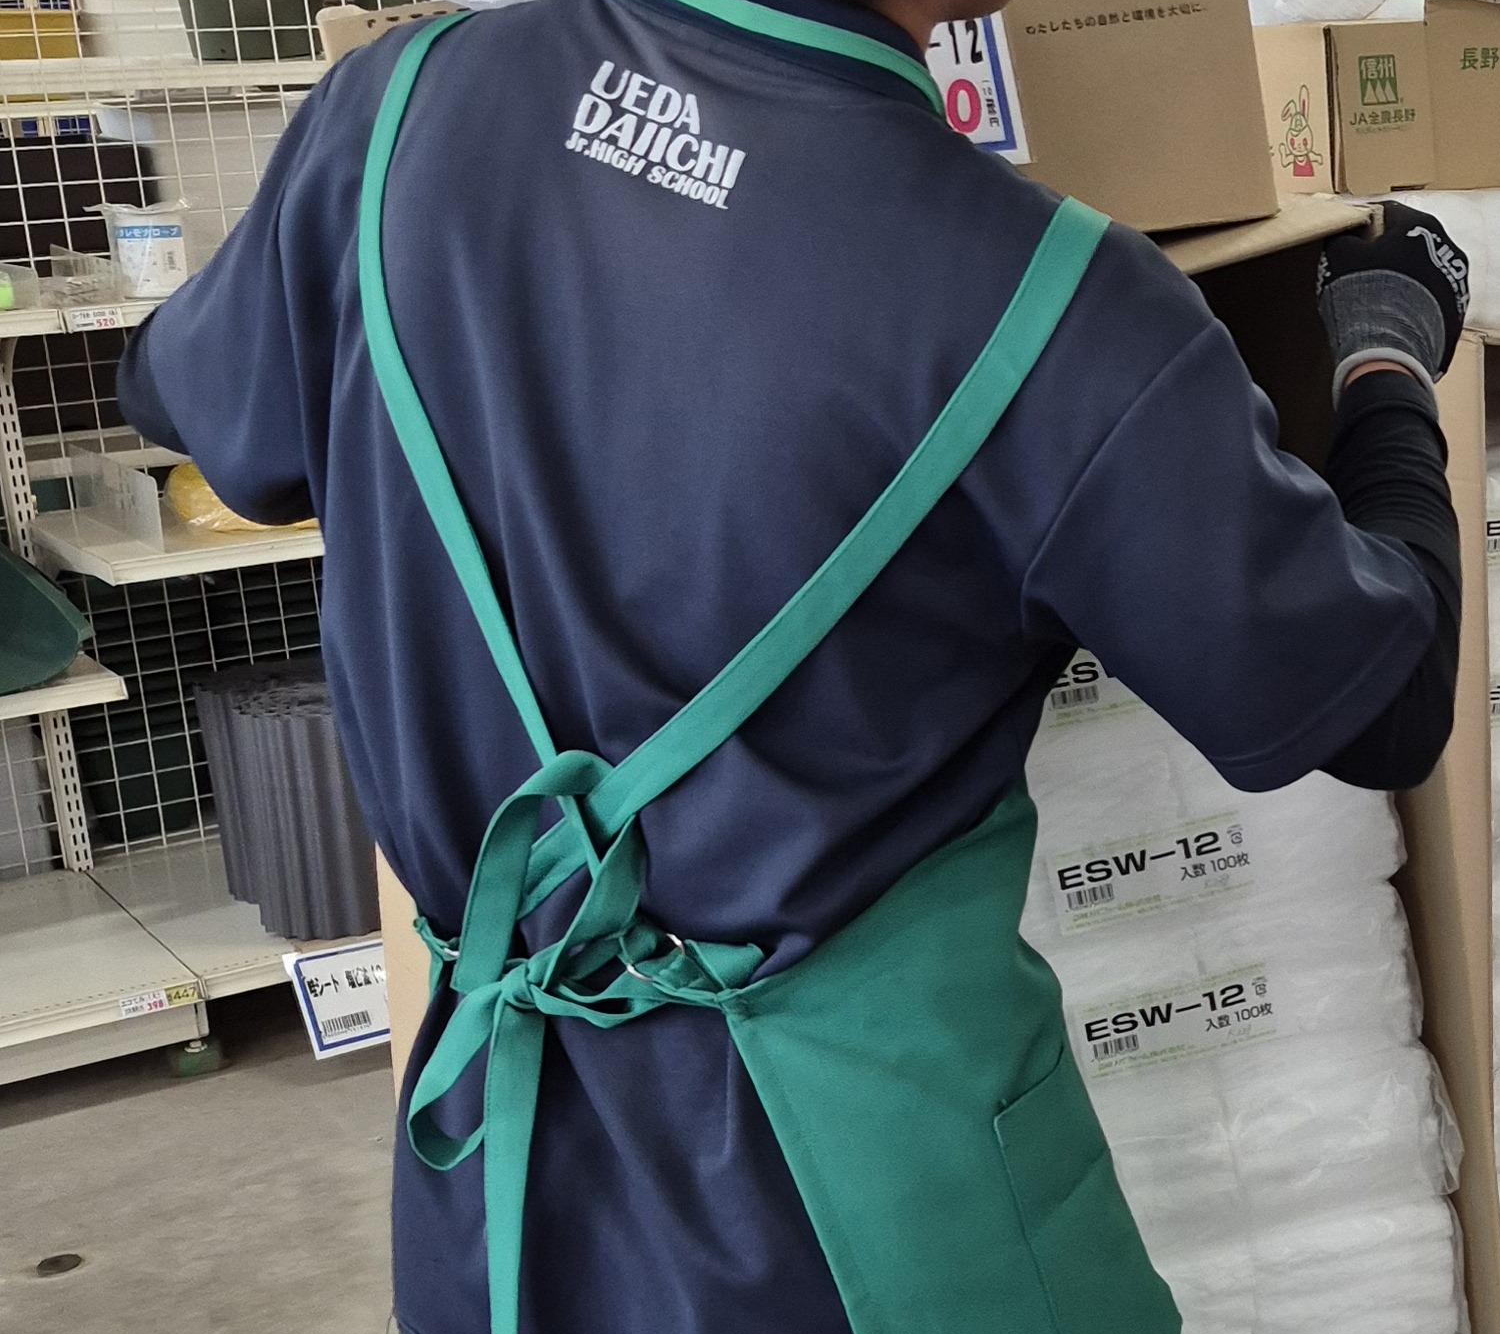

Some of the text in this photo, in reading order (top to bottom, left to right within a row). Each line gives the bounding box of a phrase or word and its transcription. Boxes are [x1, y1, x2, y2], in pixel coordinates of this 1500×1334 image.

[927, 20, 984, 66] -12
[1360, 57, 1395, 79] 信州
[590, 59, 701, 135] UEDA
[945, 77, 982, 134] 0
[1350, 108, 1416, 126] JA全農長野
[572, 93, 747, 189] DAIICHI
[564, 130, 730, 210] Jr.HIGH SCHOOL
[1057, 831, 1222, 890] ESW-12
[1180, 850, 1250, 881] 入数 100枚
[147, 999, 164, 1011] 398
[172, 987, 197, 1001] 447
[1084, 983, 1245, 1043] ESW-12
[1205, 1002, 1274, 1032] 入数 100枚
